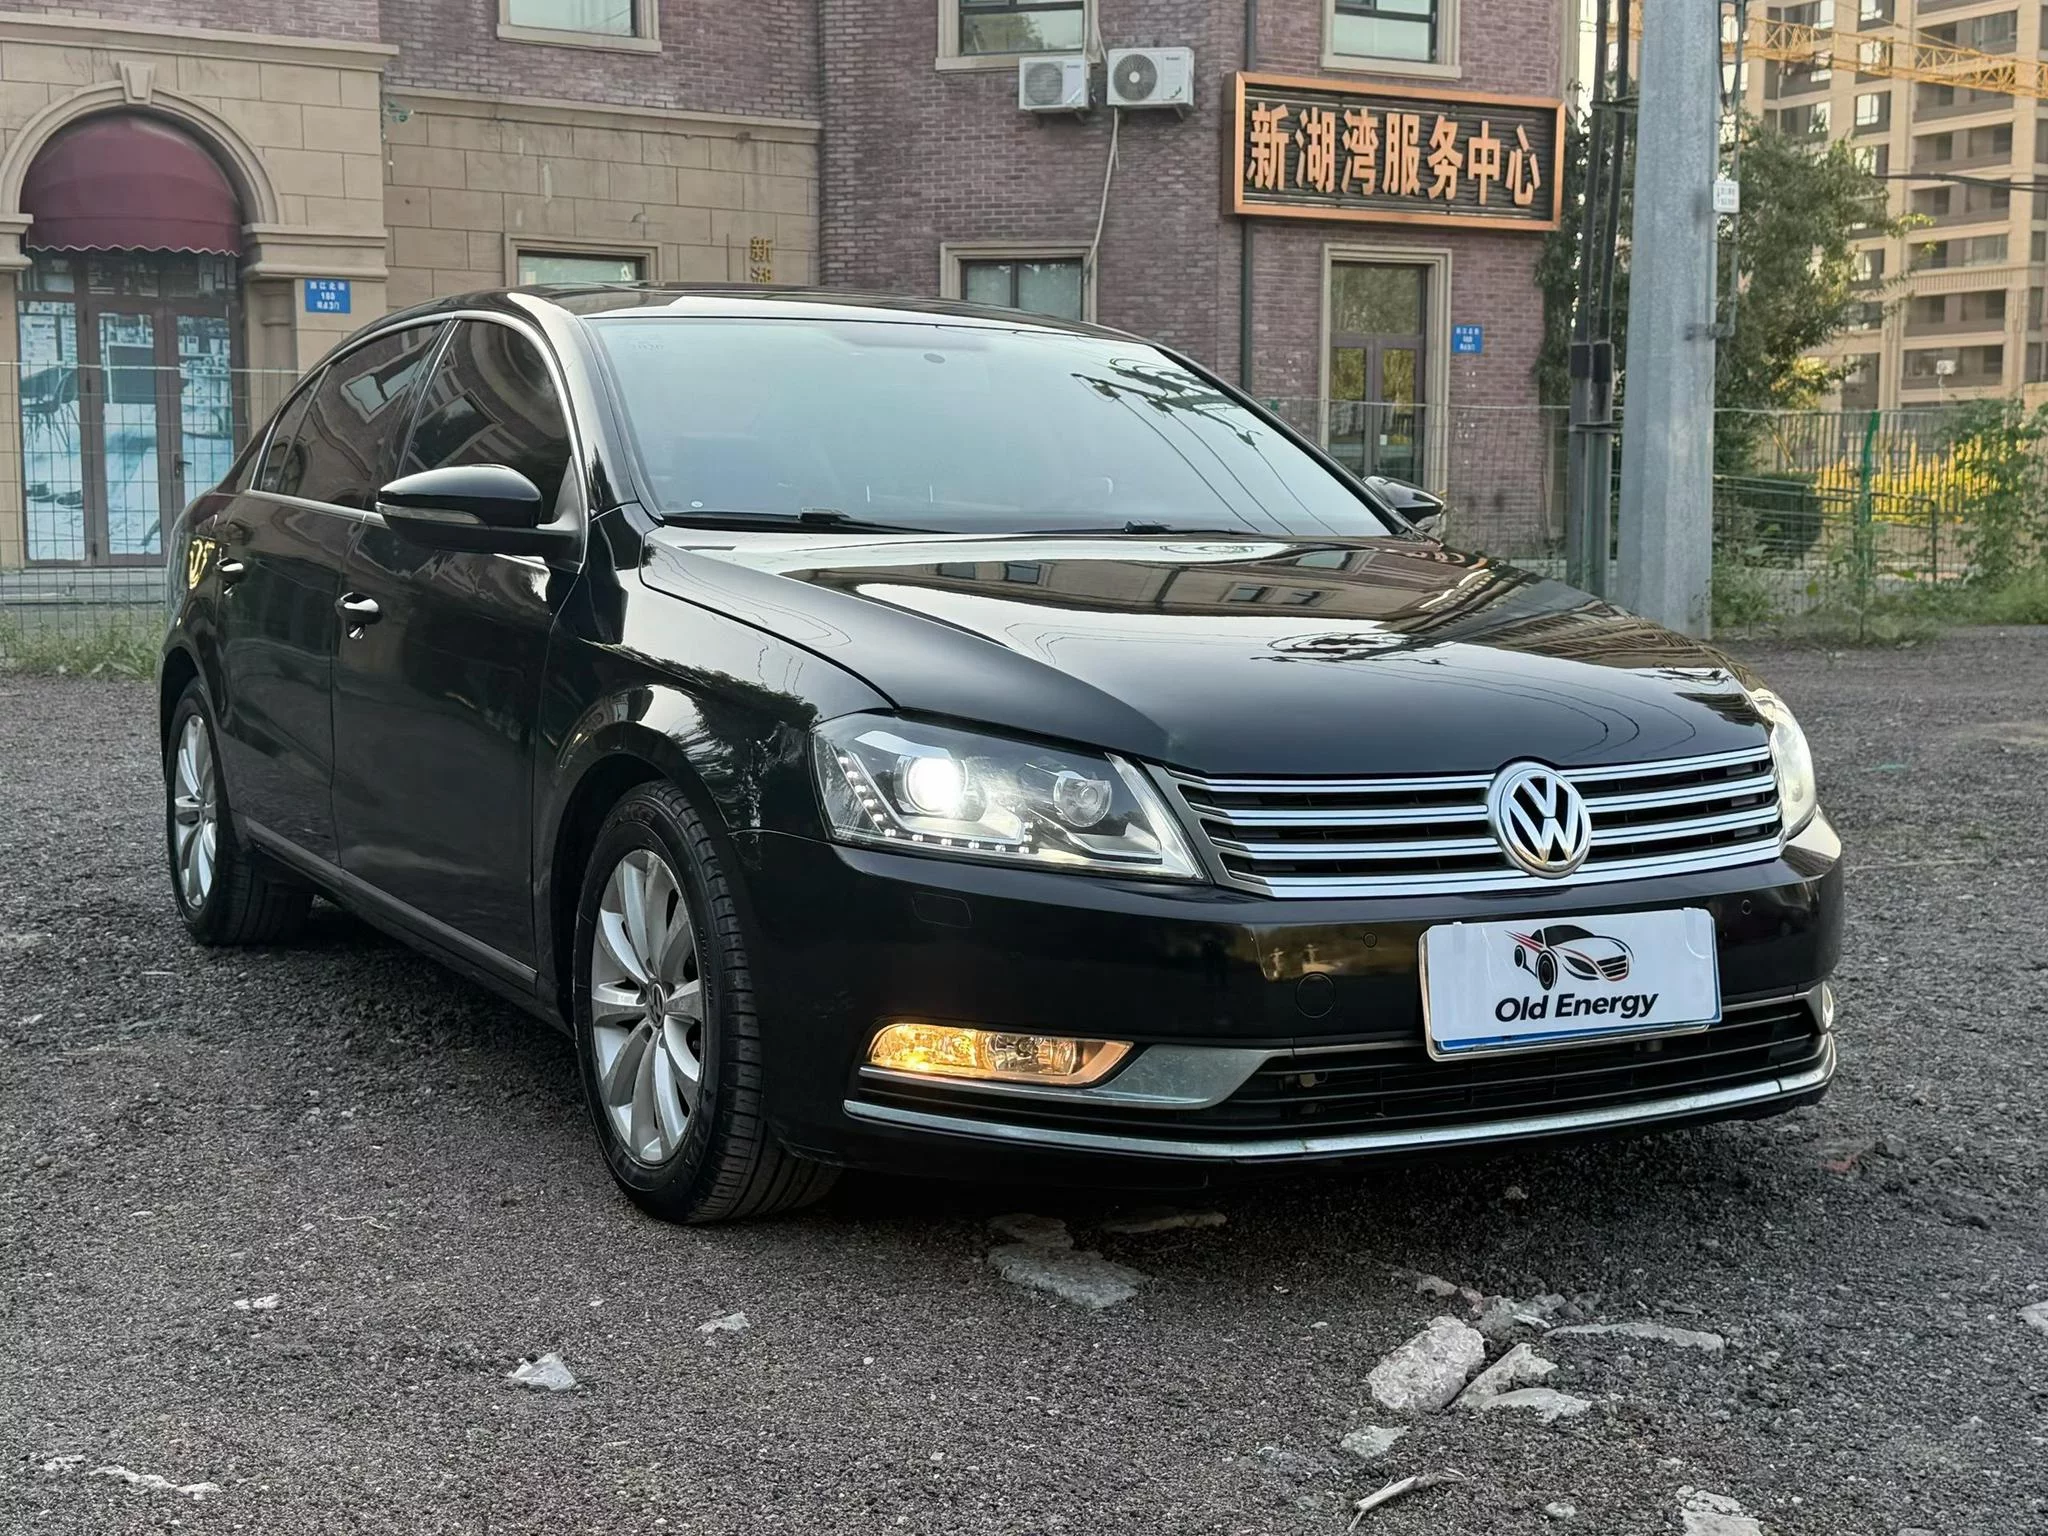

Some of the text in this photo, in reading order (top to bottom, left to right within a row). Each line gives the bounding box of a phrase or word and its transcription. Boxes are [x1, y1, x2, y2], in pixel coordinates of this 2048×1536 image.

[1246, 102, 1541, 205] 新湖湾服务中心
[1495, 993, 1659, 1022] Old Energy
